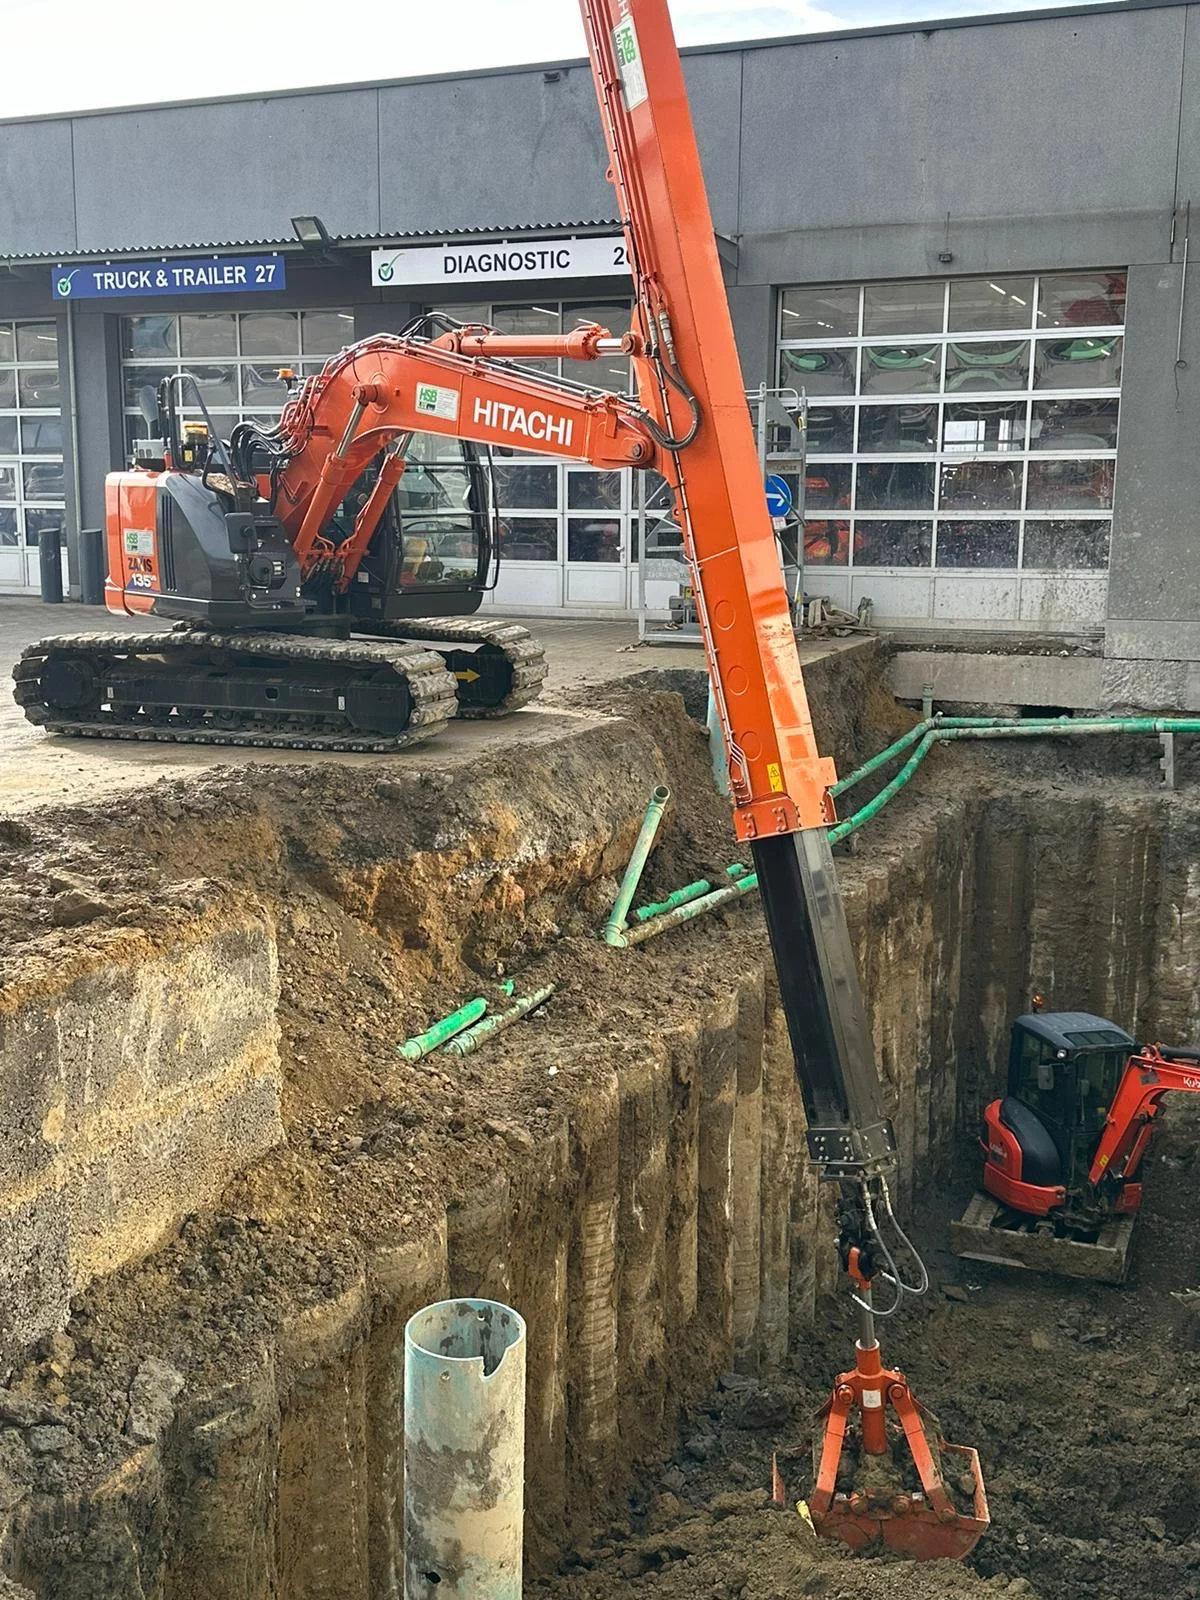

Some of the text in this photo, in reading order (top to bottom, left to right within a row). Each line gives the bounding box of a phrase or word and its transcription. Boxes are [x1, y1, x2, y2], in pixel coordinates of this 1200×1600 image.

[620, 27, 637, 63] HSB
[443, 246, 631, 274] DIAGNOSTIC 2
[93, 264, 276, 290] TRUCK & TRAILER 27
[419, 387, 438, 403] HSB
[473, 397, 574, 447] HITACHI
